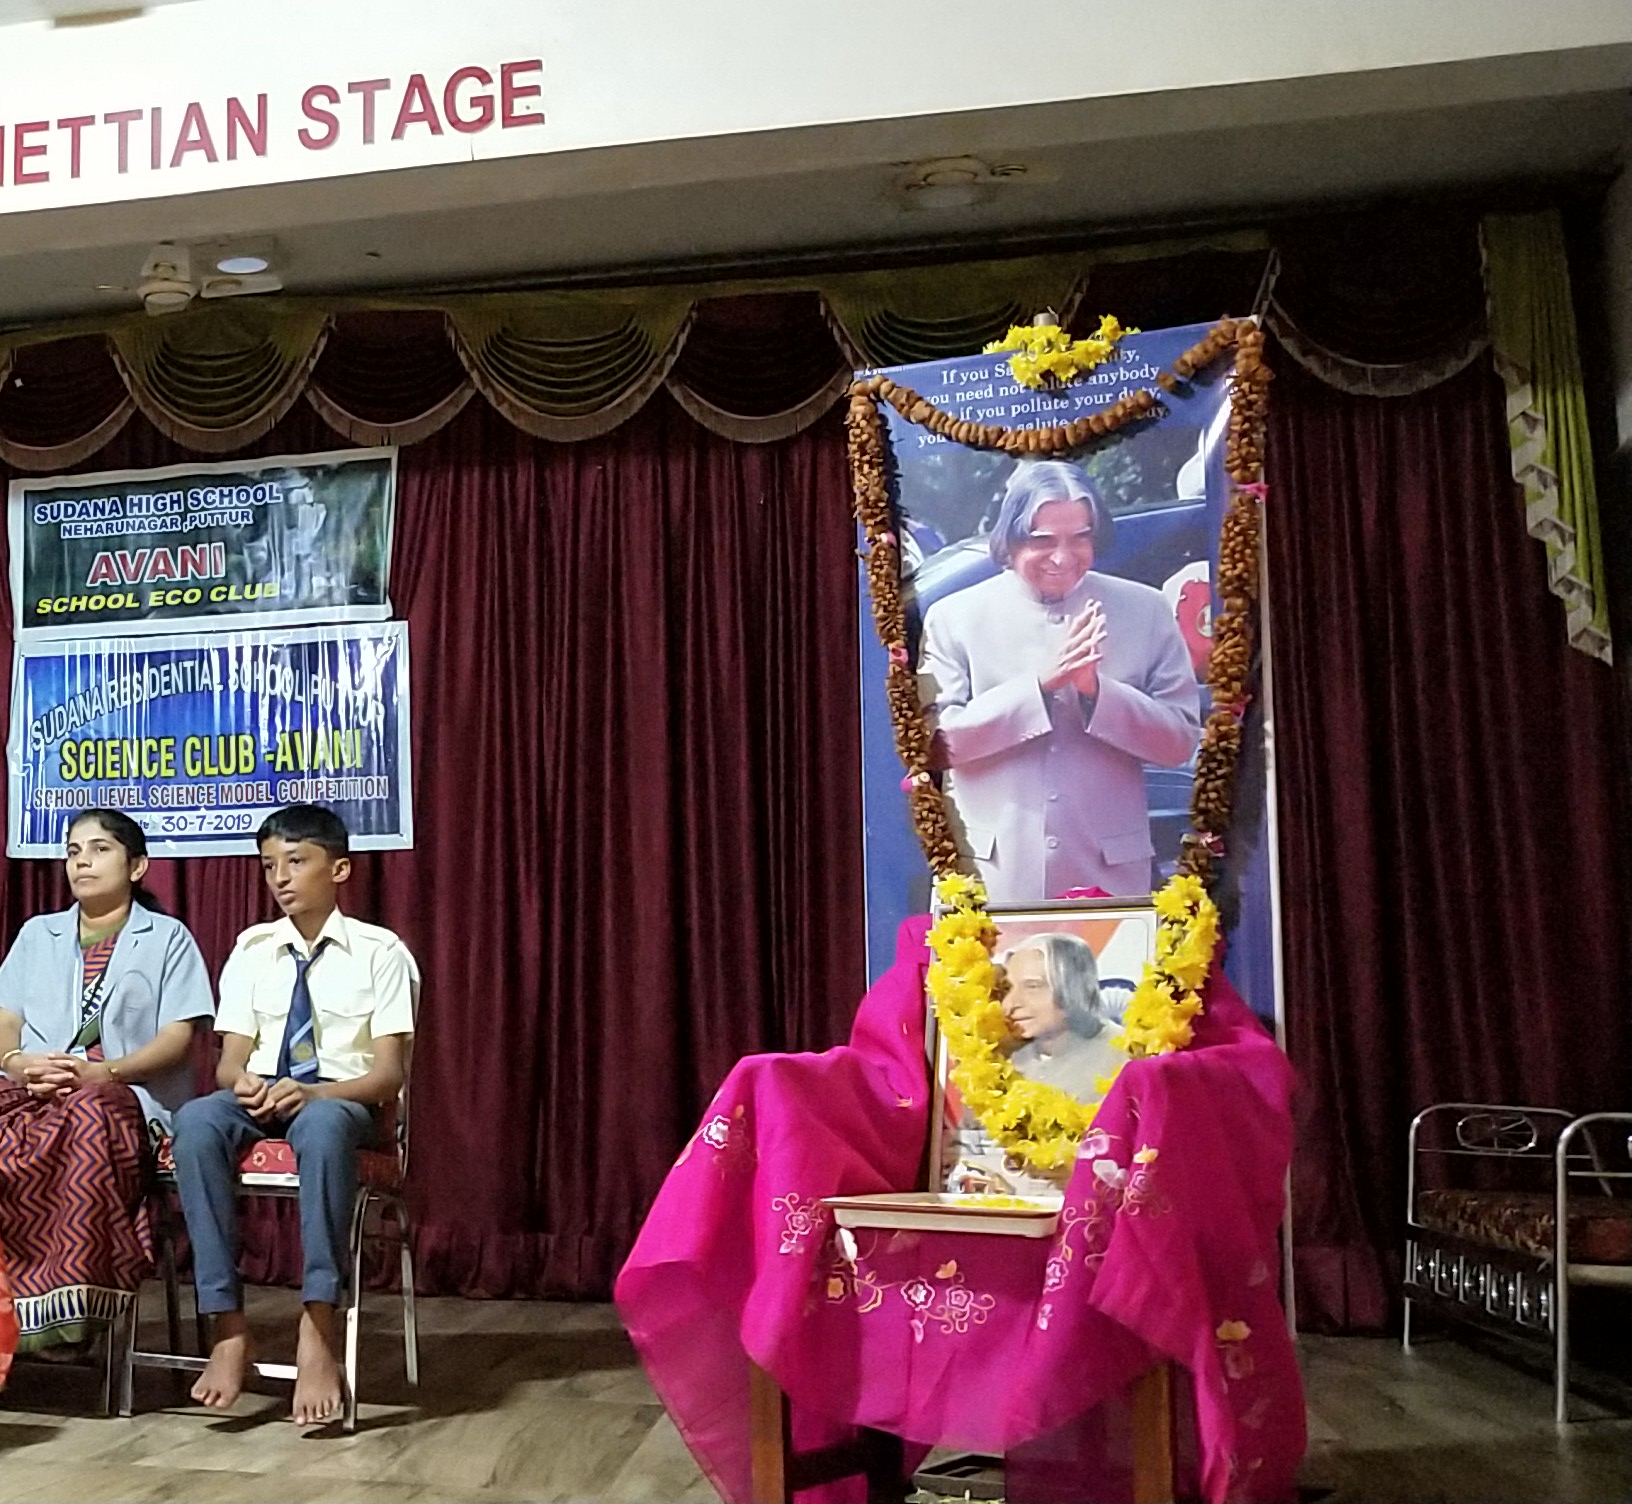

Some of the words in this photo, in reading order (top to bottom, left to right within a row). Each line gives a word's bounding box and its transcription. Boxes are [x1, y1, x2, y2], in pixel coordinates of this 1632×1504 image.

[295, 57, 546, 151] STAGE
[941, 369, 957, 385] If
[960, 368, 989, 385] you
[956, 384, 993, 402] need
[999, 383, 1025, 398] not
[1030, 375, 1083, 392] alute
[1086, 362, 1160, 386] anybody
[959, 406, 972, 422] if
[976, 406, 1006, 423] you
[1011, 396, 1070, 417] pollute
[1074, 391, 1114, 410] your
[34, 496, 121, 524] SUDANA
[126, 490, 183, 516] HIGH
[189, 483, 282, 508] SCHOOL
[61, 516, 180, 539] NEHARUNAGAR
[86, 542, 227, 587] AVANI
[36, 593, 140, 615] SCHOOL
[148, 589, 202, 607] ECO
[209, 582, 281, 603] CLUB
[30, 686, 105, 750] SUDANA
[106, 659, 224, 712] RESIDENTIAL
[228, 659, 304, 703] SCHOOL
[61, 736, 176, 781] SCIENCE
[184, 732, 256, 777] CLUB
[34, 788, 95, 809] SCHOOL
[98, 786, 146, 808] LEVEL
[149, 784, 216, 806] SCIENCE
[220, 780, 273, 804] MODEL
[278, 775, 390, 803] COMPETITION
[161, 813, 253, 833] 30-7-2019
